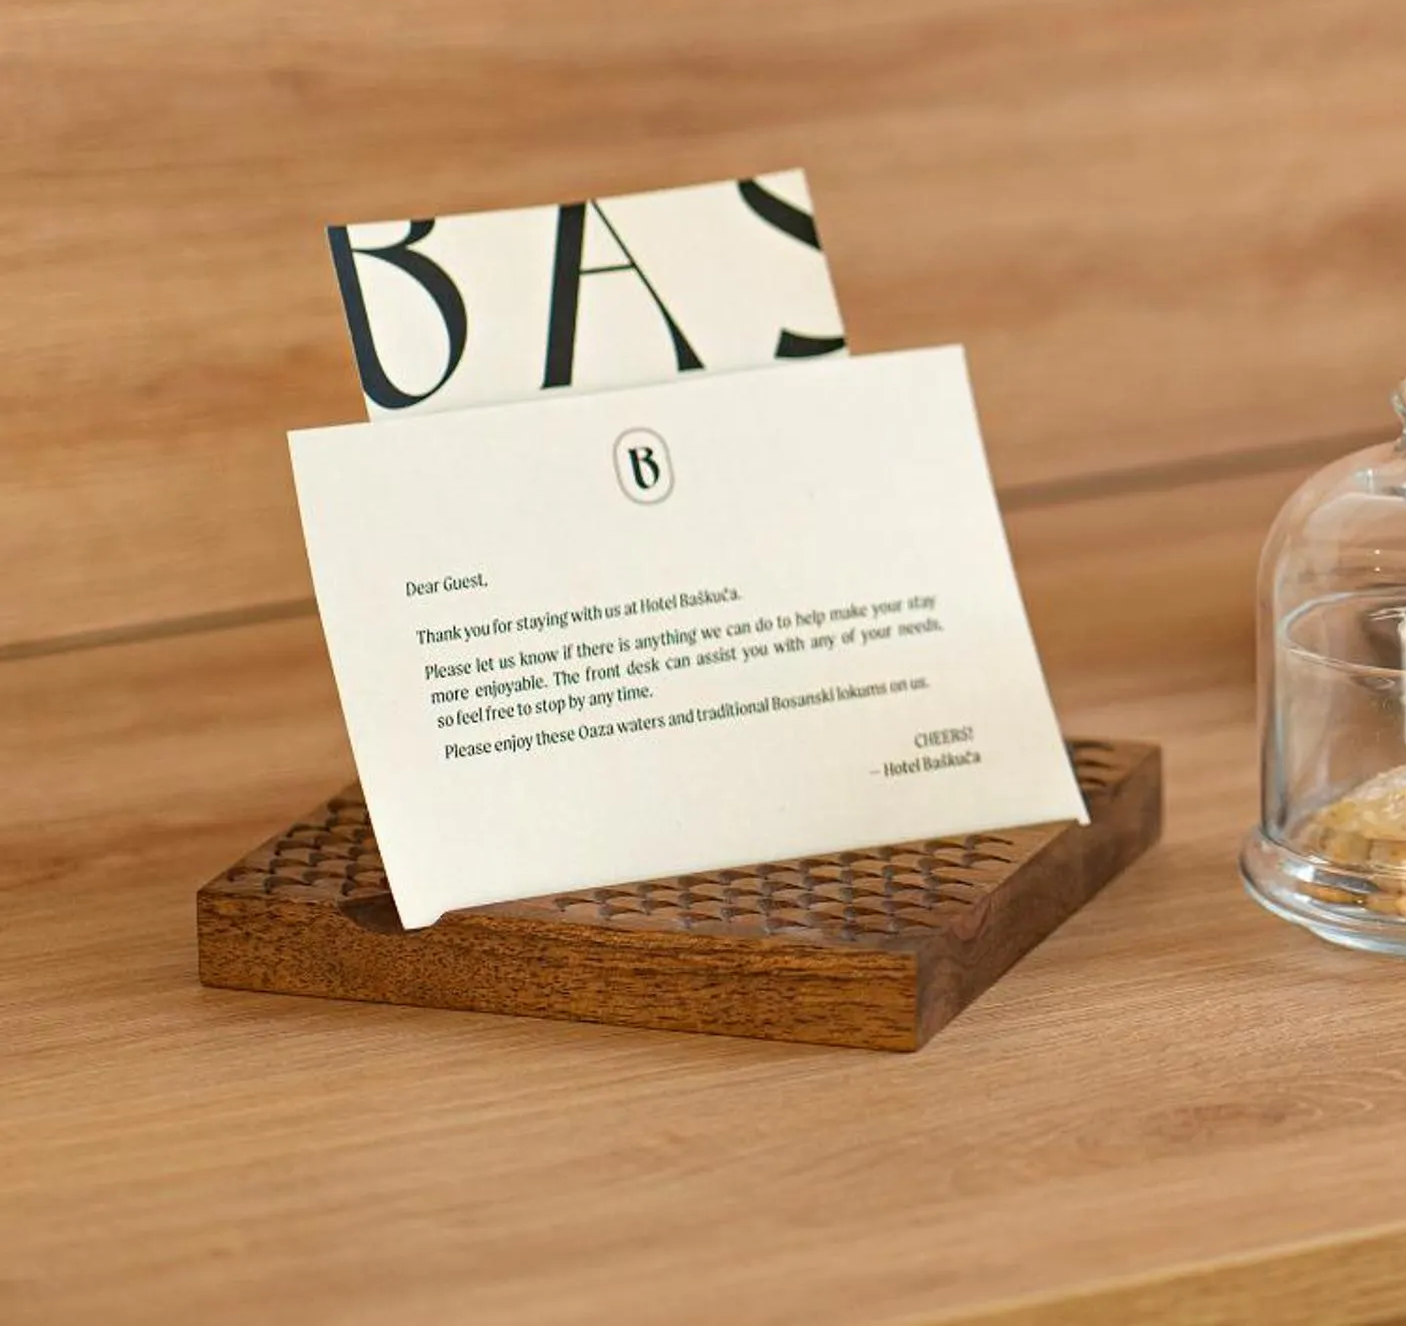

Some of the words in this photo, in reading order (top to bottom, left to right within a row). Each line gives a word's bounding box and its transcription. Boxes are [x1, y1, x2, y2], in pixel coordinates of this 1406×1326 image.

[406, 581, 440, 597] Dear
[443, 574, 488, 592] Guest,
[416, 625, 462, 645] Thank
[464, 624, 490, 642] you
[493, 618, 514, 635] for
[516, 610, 569, 632] staying
[571, 604, 601, 623] with
[605, 605, 621, 619] us
[624, 600, 638, 615] at
[640, 594, 677, 614] Hotel
[425, 661, 471, 680] Please
[475, 657, 495, 673] let
[500, 655, 516, 669] us
[519, 649, 558, 667] know
[563, 644, 572, 661] if
[577, 641, 614, 658] there
[618, 637, 631, 652] is
[635, 627, 697, 651] anything
[701, 626, 722, 639] we
[726, 621, 751, 637] can
[755, 617, 773, 632] do
[777, 615, 792, 629] to
[795, 608, 826, 626] help
[830, 603, 868, 620] make
[871, 599, 902, 618] your
[907, 594, 936, 610] stay
[431, 688, 469, 704] more
[475, 675, 548, 698] enjoyable.
[553, 671, 580, 686] The
[586, 664, 621, 682] front
[626, 658, 660, 675] desk
[665, 655, 691, 670] can
[697, 647, 738, 666] assist
[742, 644, 768, 663] you
[773, 636, 805, 653] with
[811, 633, 836, 651] any
[841, 628, 857, 645] of
[861, 625, 891, 645] your
[437, 715, 454, 728] so
[457, 708, 482, 726] feel
[485, 705, 514, 721] free
[517, 703, 532, 716] to
[535, 697, 567, 714] stop
[569, 694, 585, 712] by
[589, 691, 614, 707] any
[617, 685, 654, 702] time.
[445, 740, 492, 759] Please
[495, 734, 533, 752] enjoy
[536, 728, 575, 745] these
[579, 723, 614, 740] Oaza
[616, 715, 666, 734] waters
[669, 708, 694, 726] and
[697, 697, 769, 722] traditional
[772, 687, 835, 711] Bosanski
[837, 681, 887, 701] lokums
[890, 679, 907, 694] on
[910, 677, 930, 690] us.
[884, 759, 920, 778] Hotel
